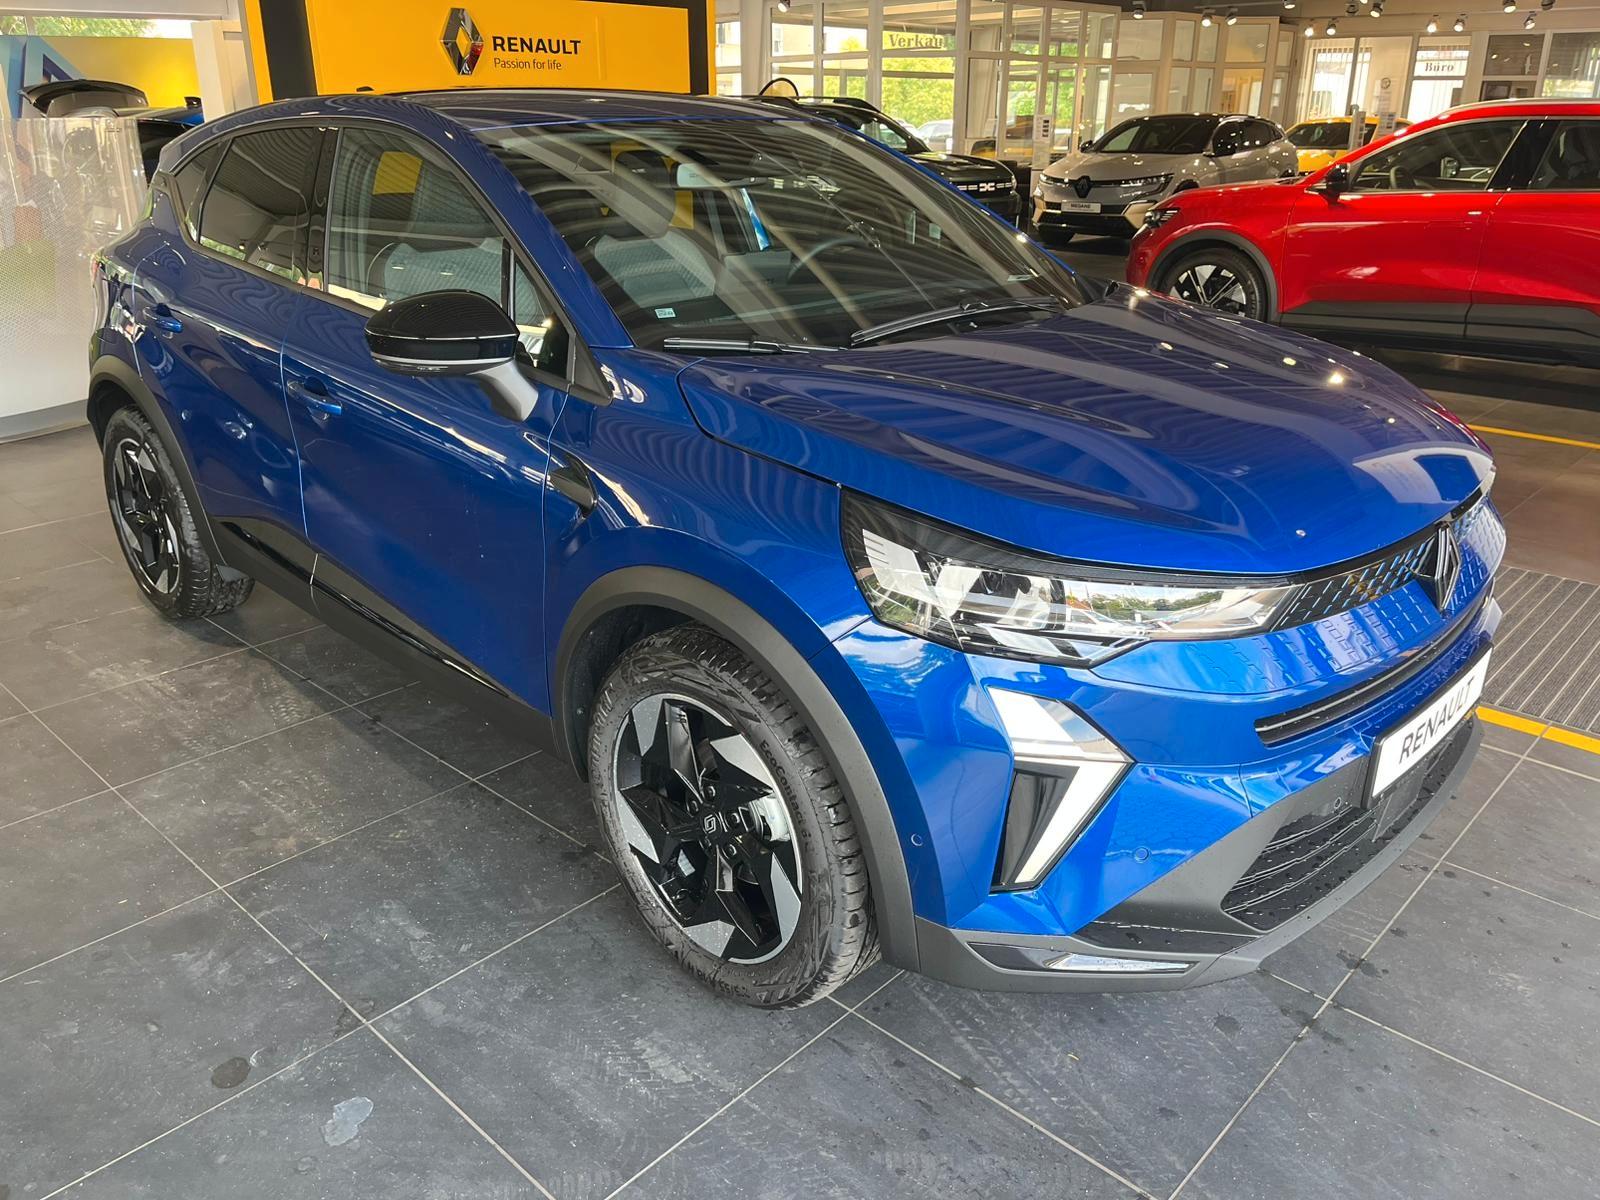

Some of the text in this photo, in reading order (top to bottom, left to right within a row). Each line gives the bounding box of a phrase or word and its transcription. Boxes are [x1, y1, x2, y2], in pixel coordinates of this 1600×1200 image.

[492, 36, 581, 55] RENAULT
[889, 33, 948, 48] Verkau
[493, 57, 562, 70] Passion for life
[1398, 675, 1475, 765] RENAULT
